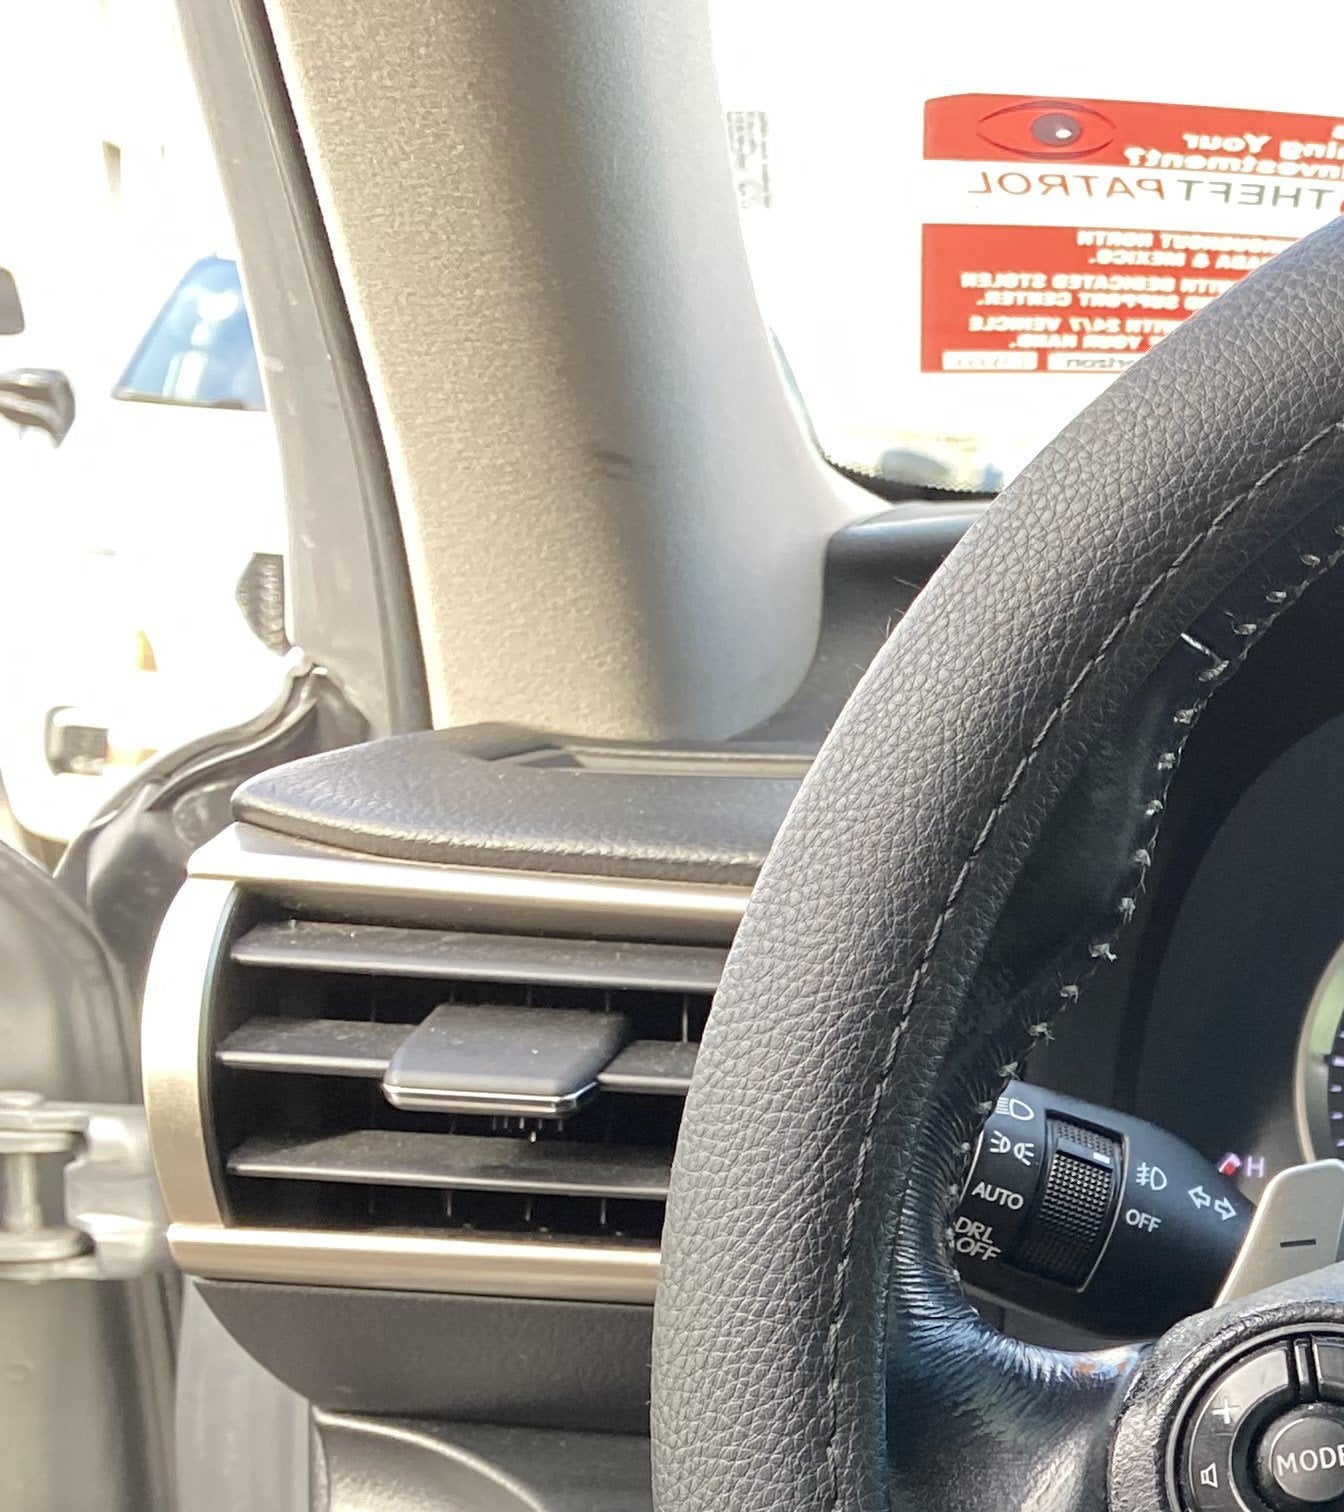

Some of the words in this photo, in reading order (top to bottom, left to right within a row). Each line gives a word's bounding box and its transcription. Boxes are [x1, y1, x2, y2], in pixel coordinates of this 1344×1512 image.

[1245, 1157, 1265, 1178] H
[971, 1181, 1025, 1211] AUTO
[954, 1216, 995, 1245] DRL
[1125, 1208, 1162, 1233] OFF
[956, 1237, 1002, 1263] OFF
